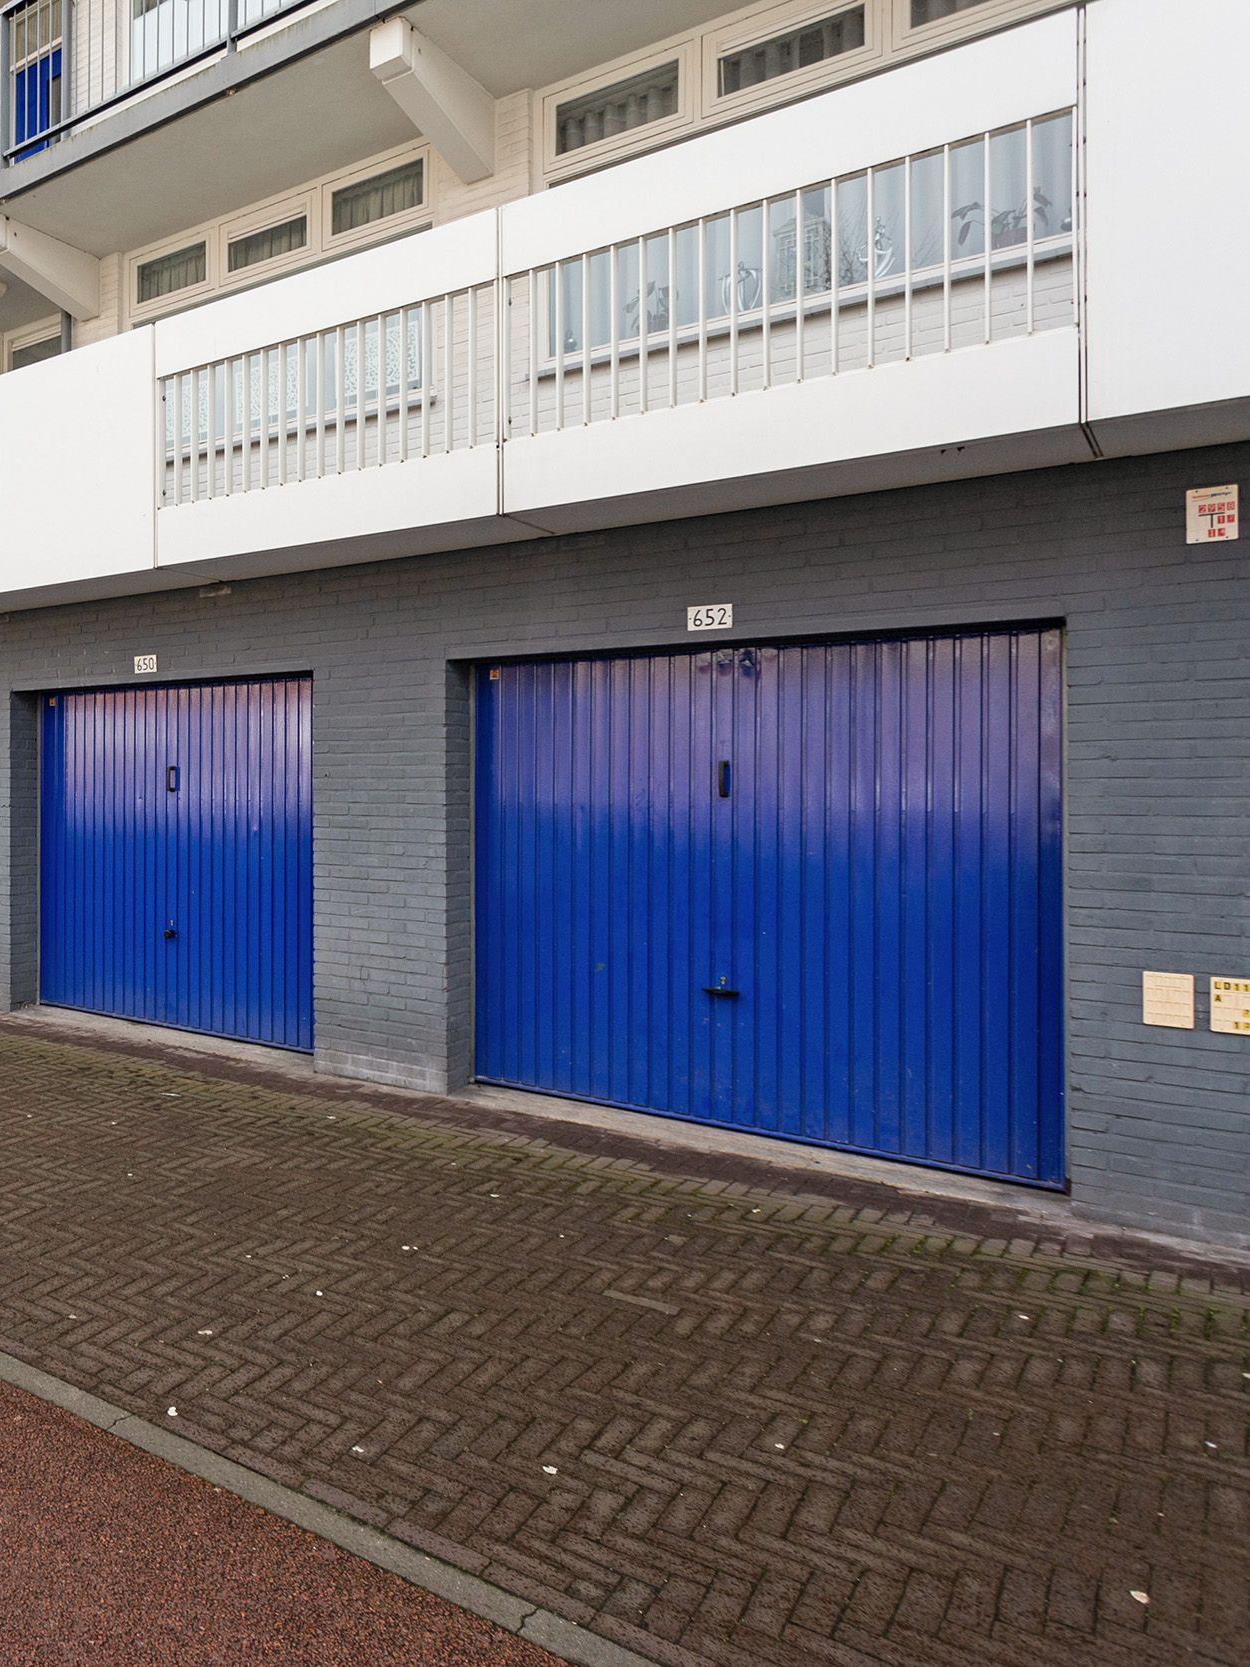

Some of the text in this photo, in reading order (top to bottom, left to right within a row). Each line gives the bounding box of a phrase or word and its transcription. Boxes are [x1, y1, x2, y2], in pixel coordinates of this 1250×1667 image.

[693, 607, 727, 627] 652
[136, 657, 155, 672] 650
[1214, 993, 1222, 1003] A
